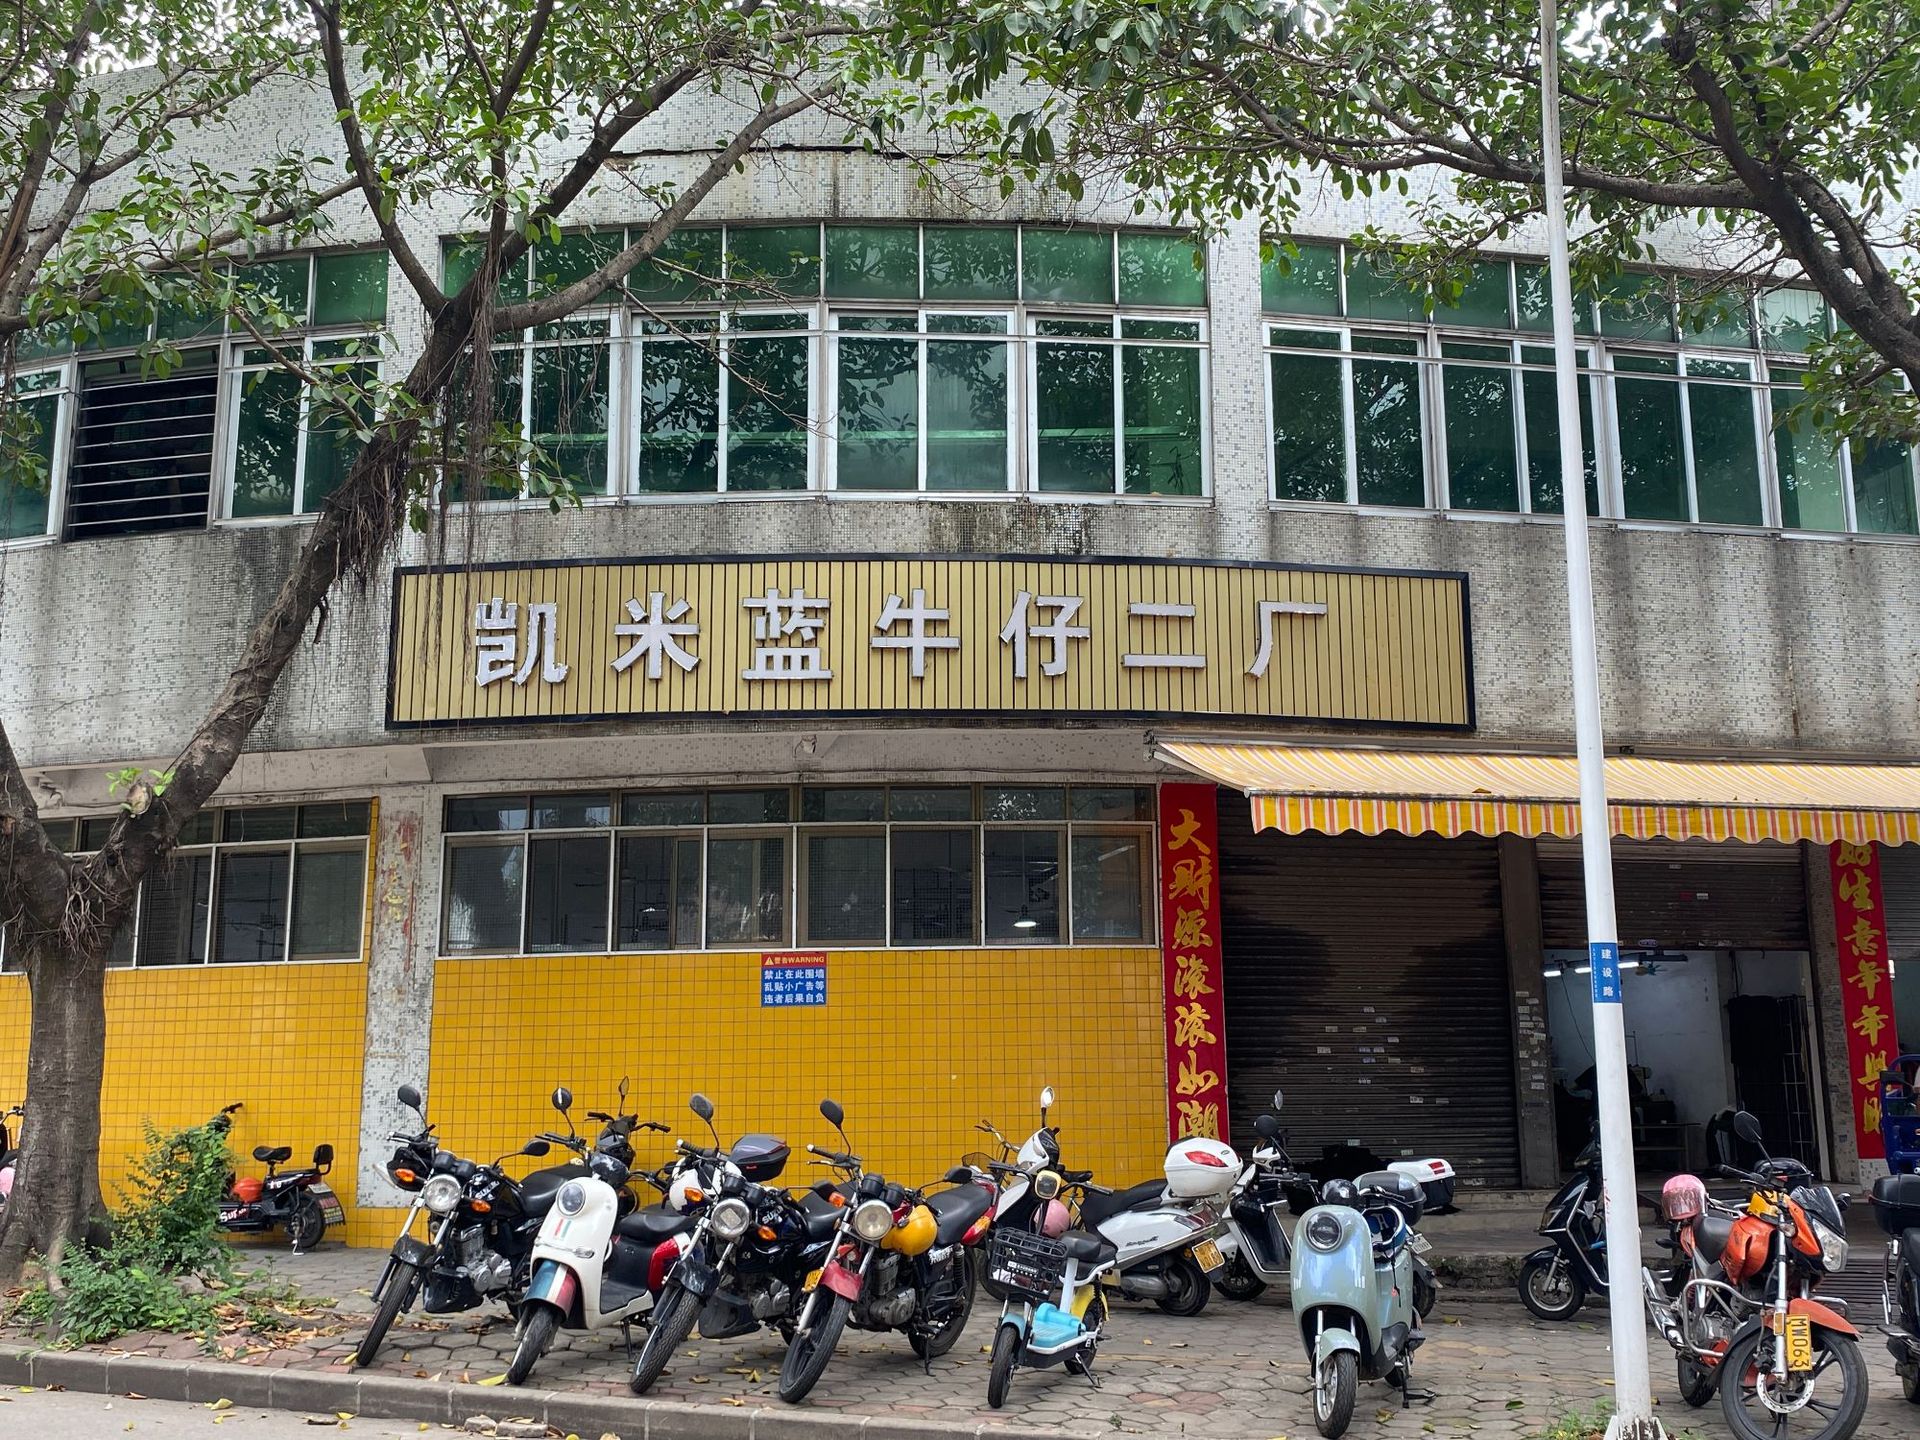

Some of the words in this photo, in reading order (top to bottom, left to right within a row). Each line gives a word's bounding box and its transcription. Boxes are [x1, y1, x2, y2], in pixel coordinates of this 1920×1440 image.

[475, 587, 1328, 687] 凯米蓝牛仔二厂
[764, 968, 825, 980] 禁止在此围墙
[764, 980, 825, 992] 乱贴小广告等
[764, 992, 825, 1004] 违者后果自负
